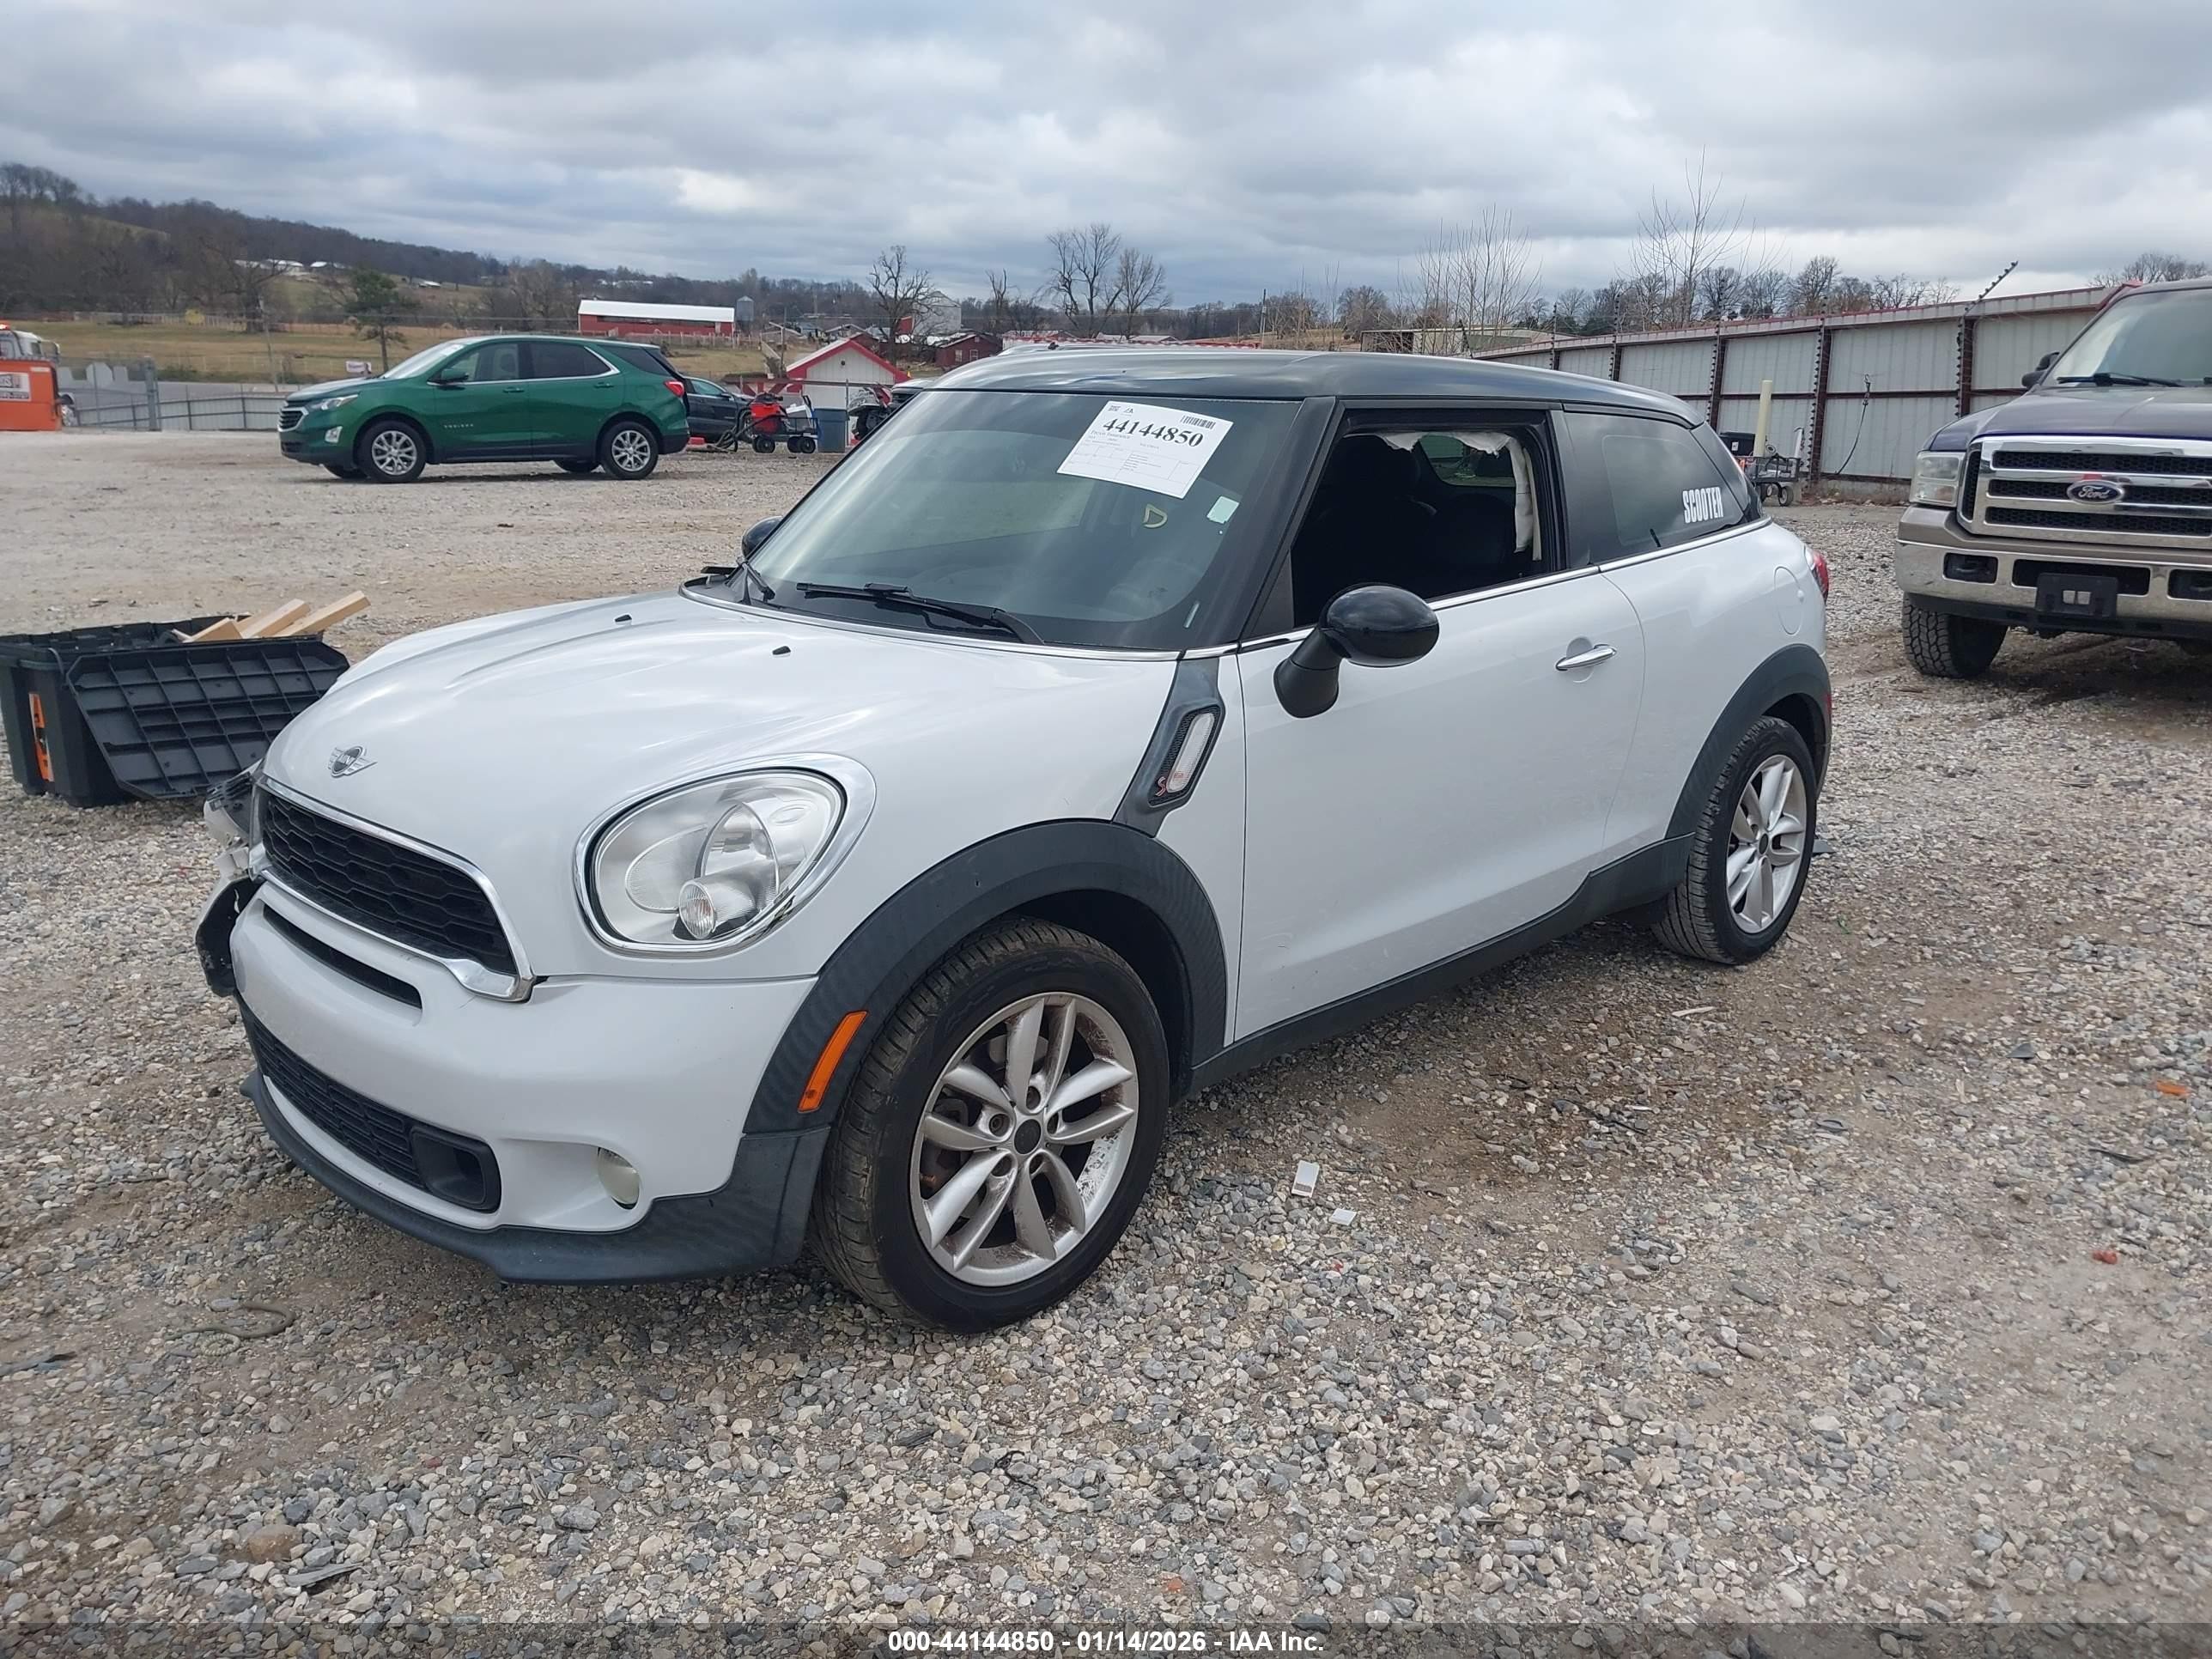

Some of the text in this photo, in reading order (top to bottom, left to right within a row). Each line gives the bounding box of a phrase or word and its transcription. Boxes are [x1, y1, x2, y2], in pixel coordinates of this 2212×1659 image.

[1103, 418, 1204, 447] 44144850
[1682, 486, 1724, 524] SCOOTER
[2077, 484, 2111, 499] Ford
